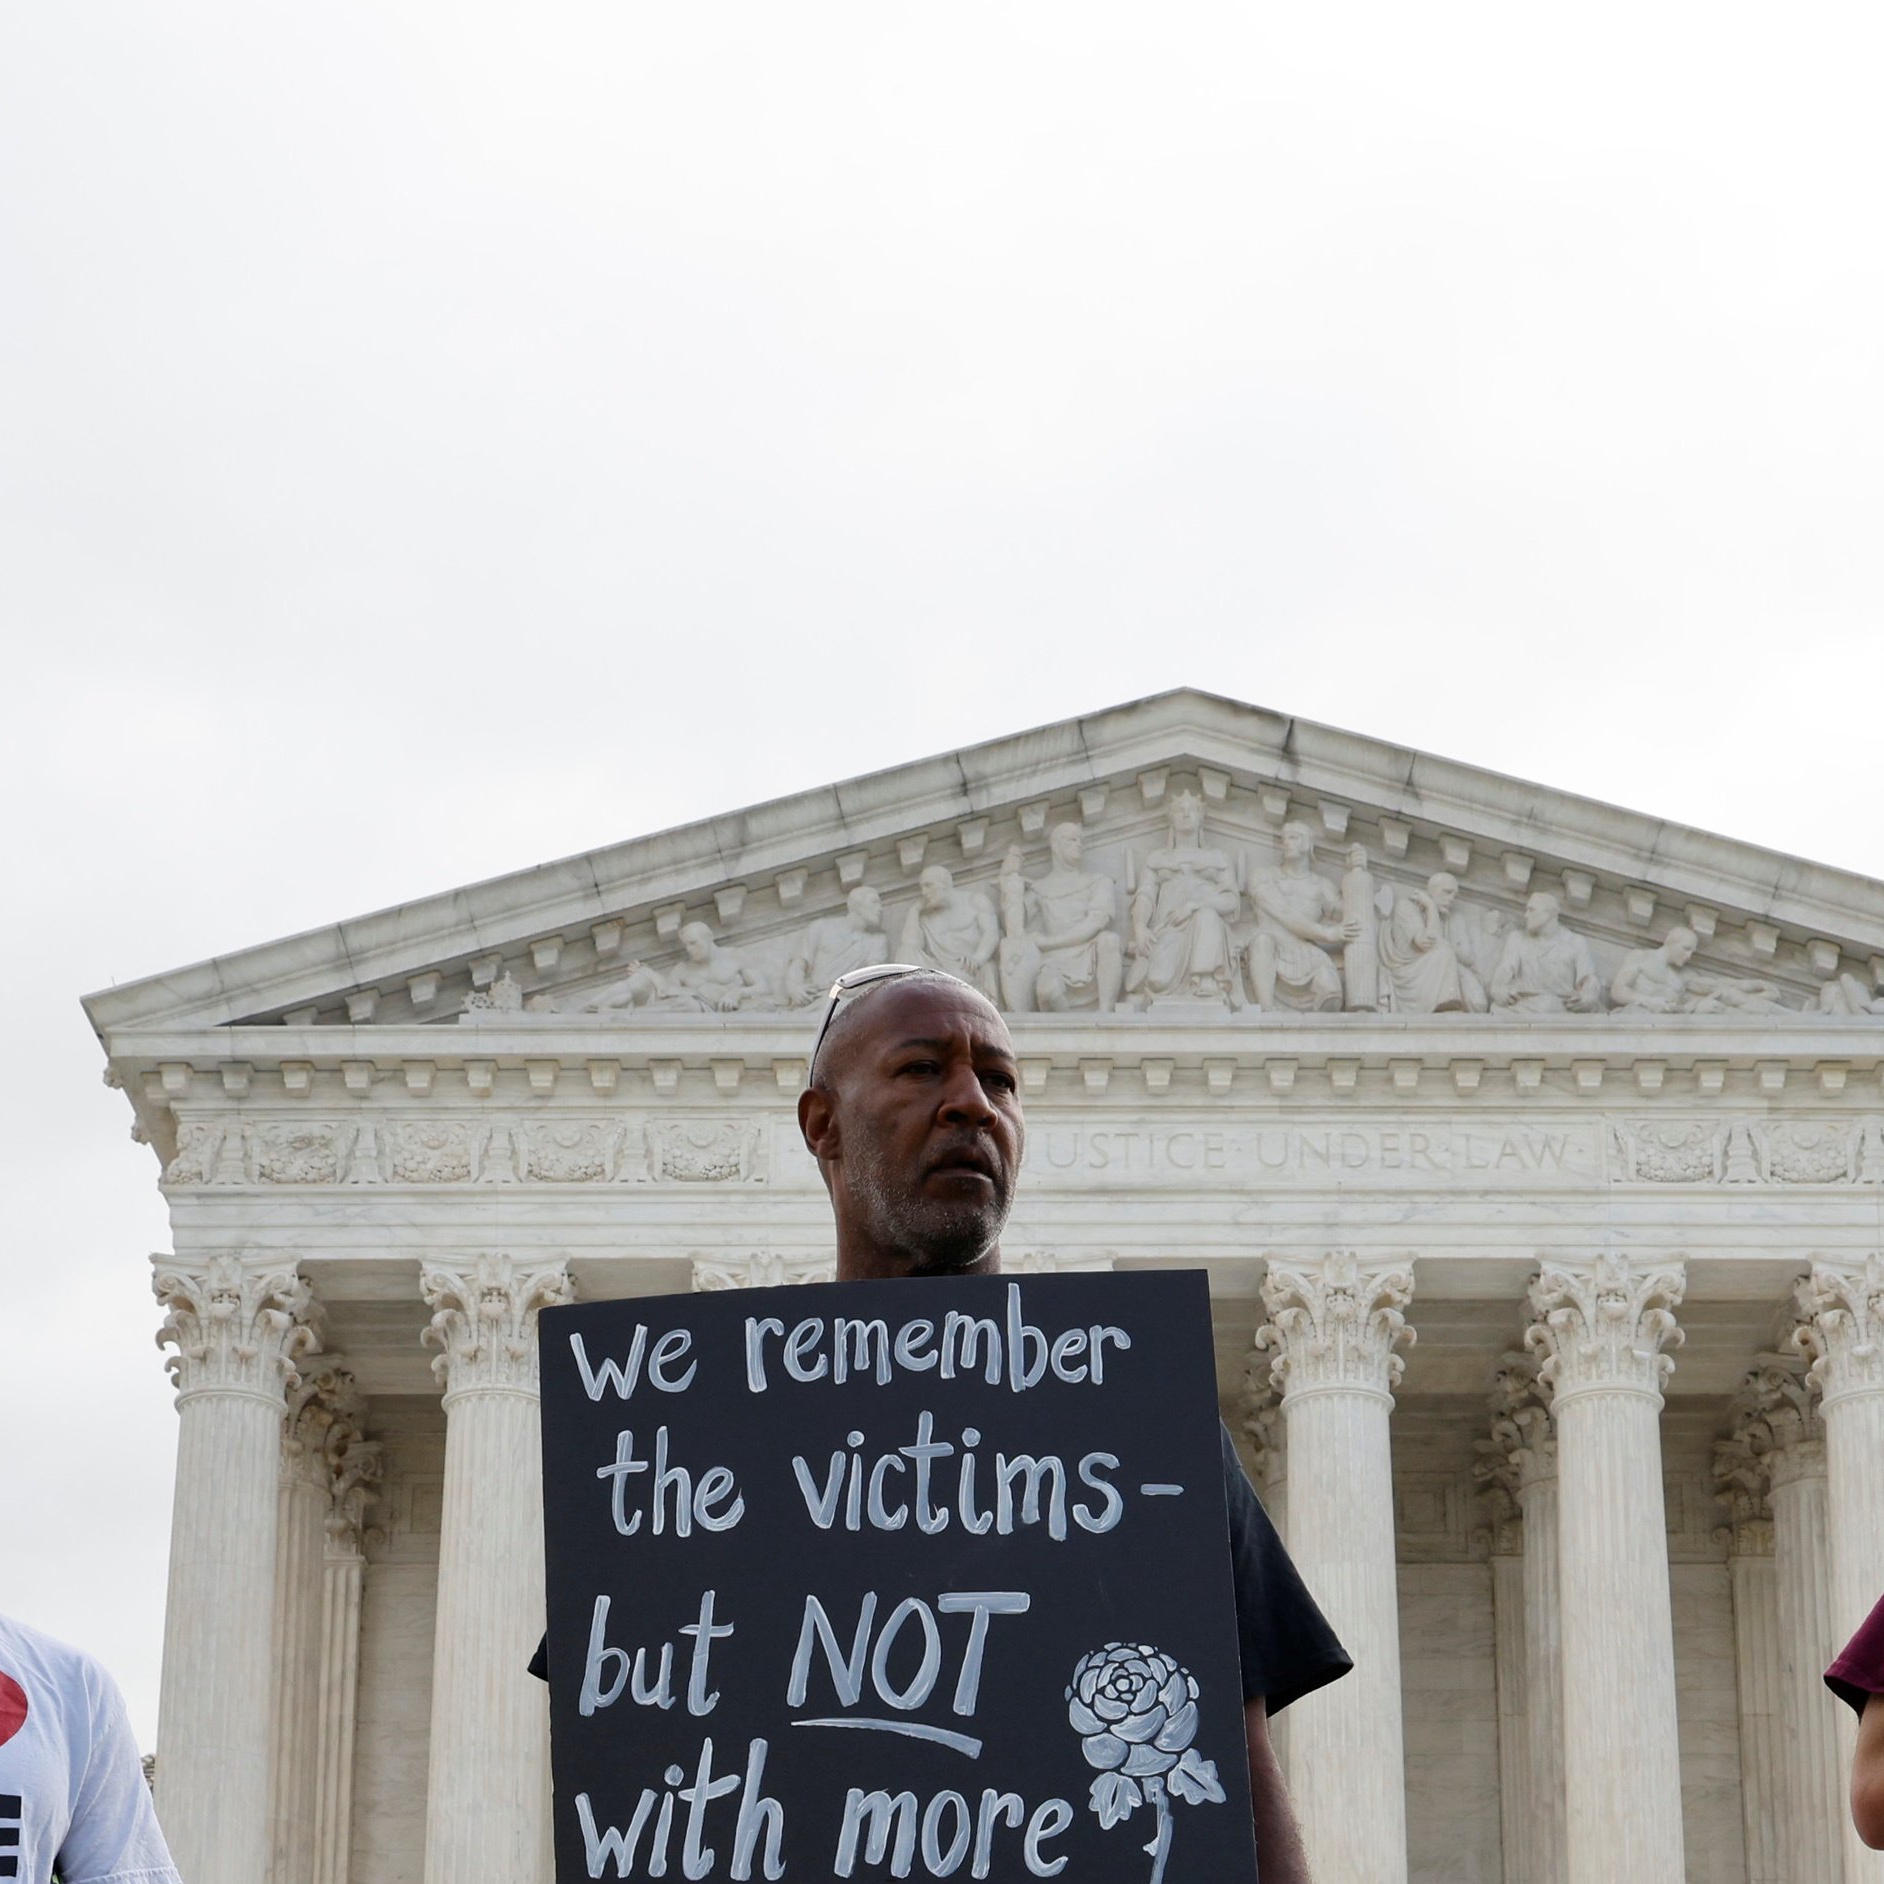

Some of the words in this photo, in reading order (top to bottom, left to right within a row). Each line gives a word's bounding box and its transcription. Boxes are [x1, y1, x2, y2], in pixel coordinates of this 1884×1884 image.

[1028, 1131, 1226, 1169] USTICE
[1257, 1131, 1444, 1169] UNDER
[1462, 1131, 1570, 1170] LAW
[744, 1282, 1132, 1394] remember
[597, 1426, 745, 1537] the
[579, 1590, 734, 1717] but
[786, 1591, 1031, 1717] NOT
[574, 1736, 786, 1881] with
[834, 1787, 1074, 1880] more
